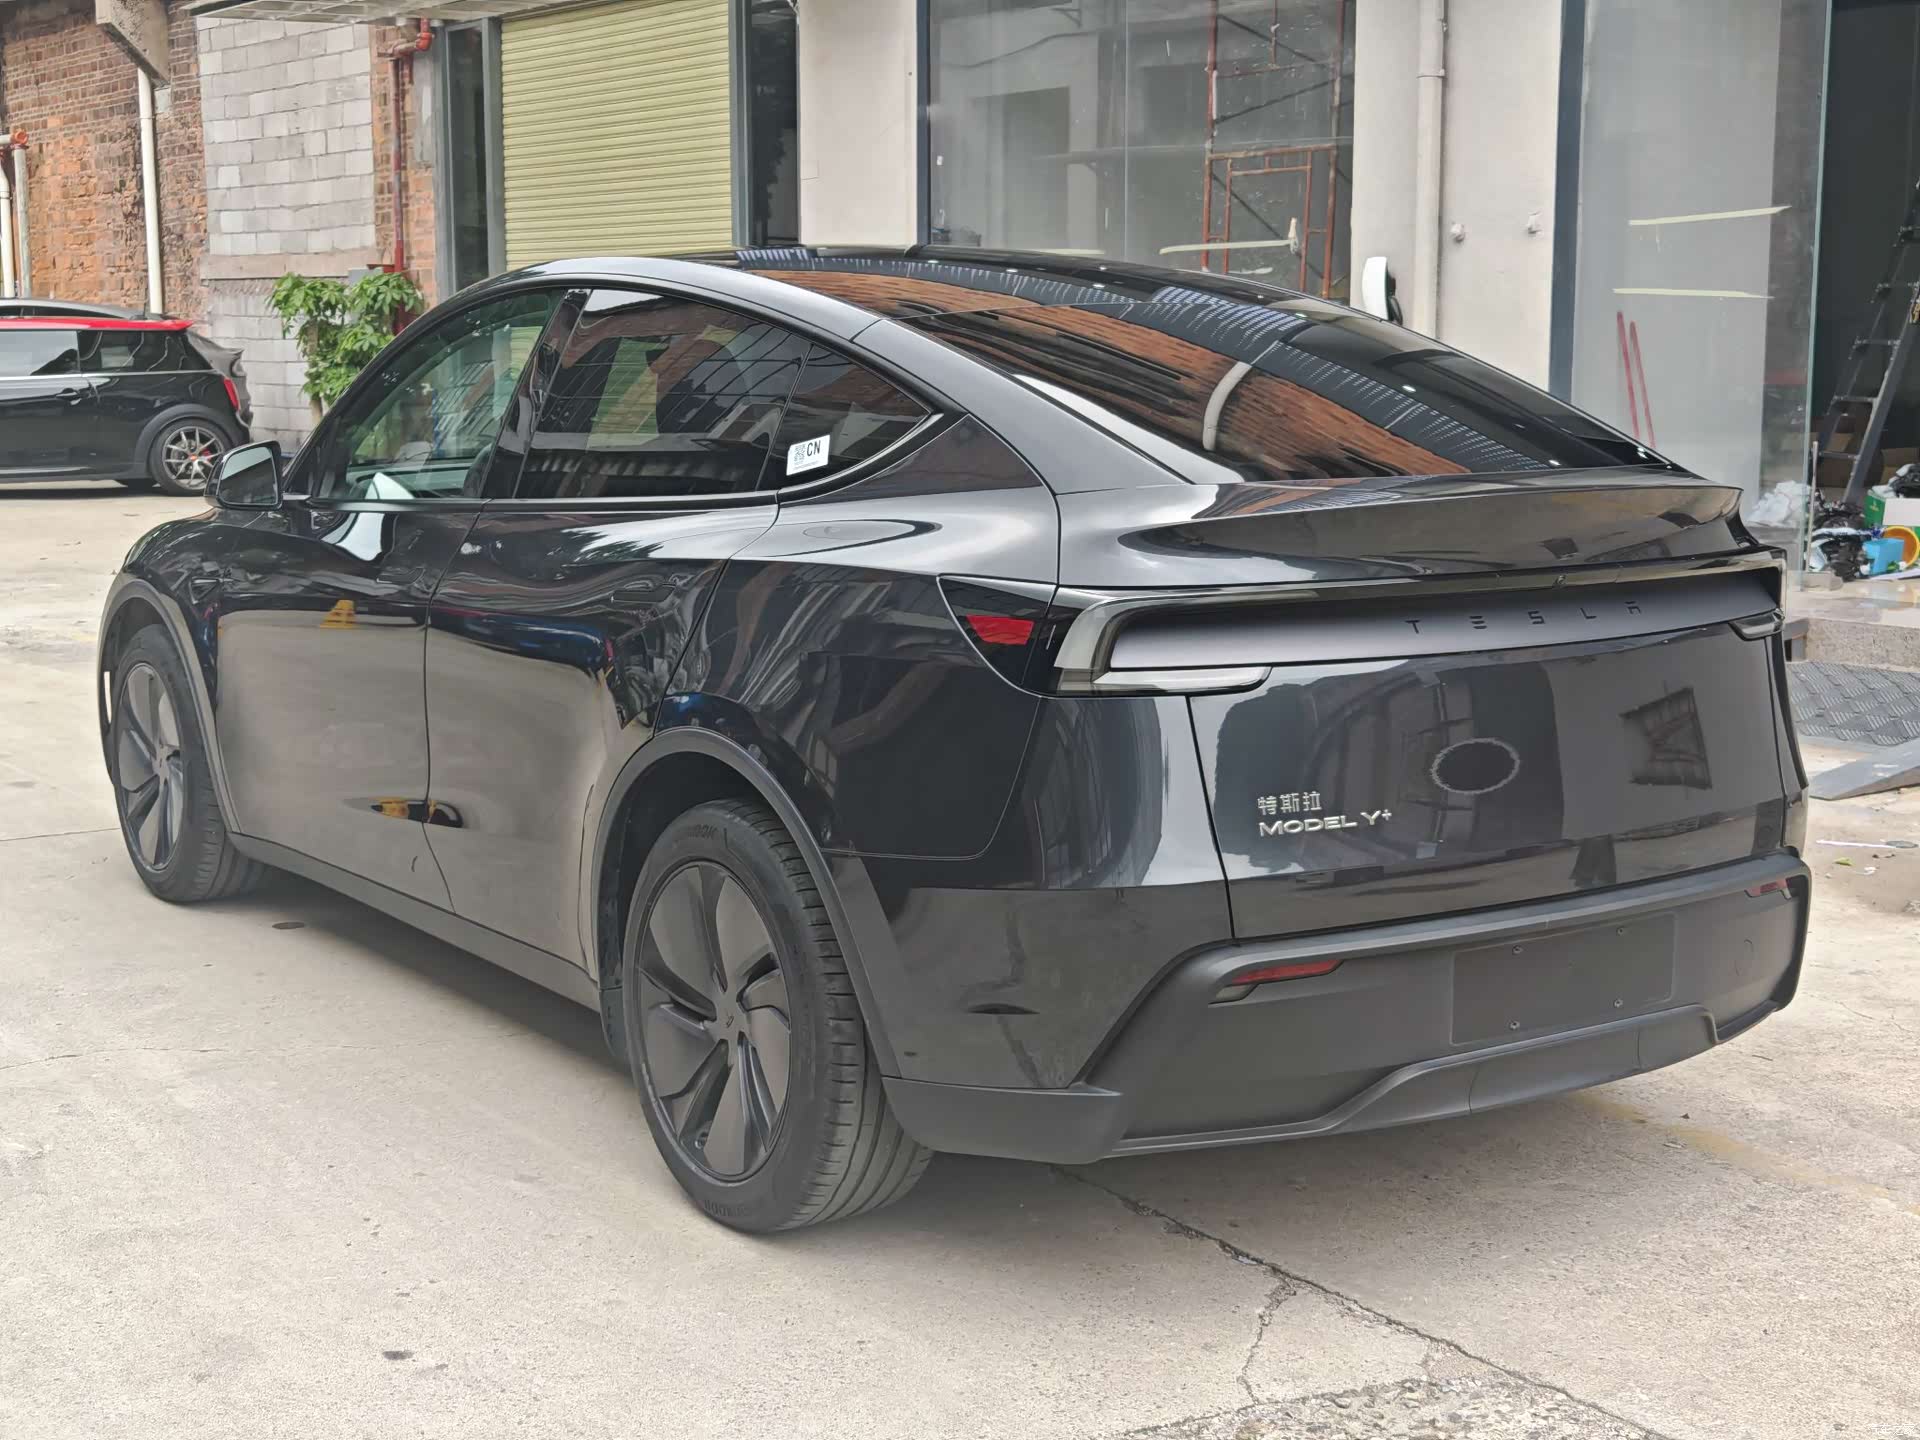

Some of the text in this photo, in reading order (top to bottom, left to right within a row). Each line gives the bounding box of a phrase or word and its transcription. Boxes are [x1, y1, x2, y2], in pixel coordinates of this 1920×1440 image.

[806, 440, 821, 457] CN
[1405, 601, 1642, 634] TESLA
[1257, 791, 1322, 816] 特斯拉
[1258, 815, 1358, 837] MODEL
